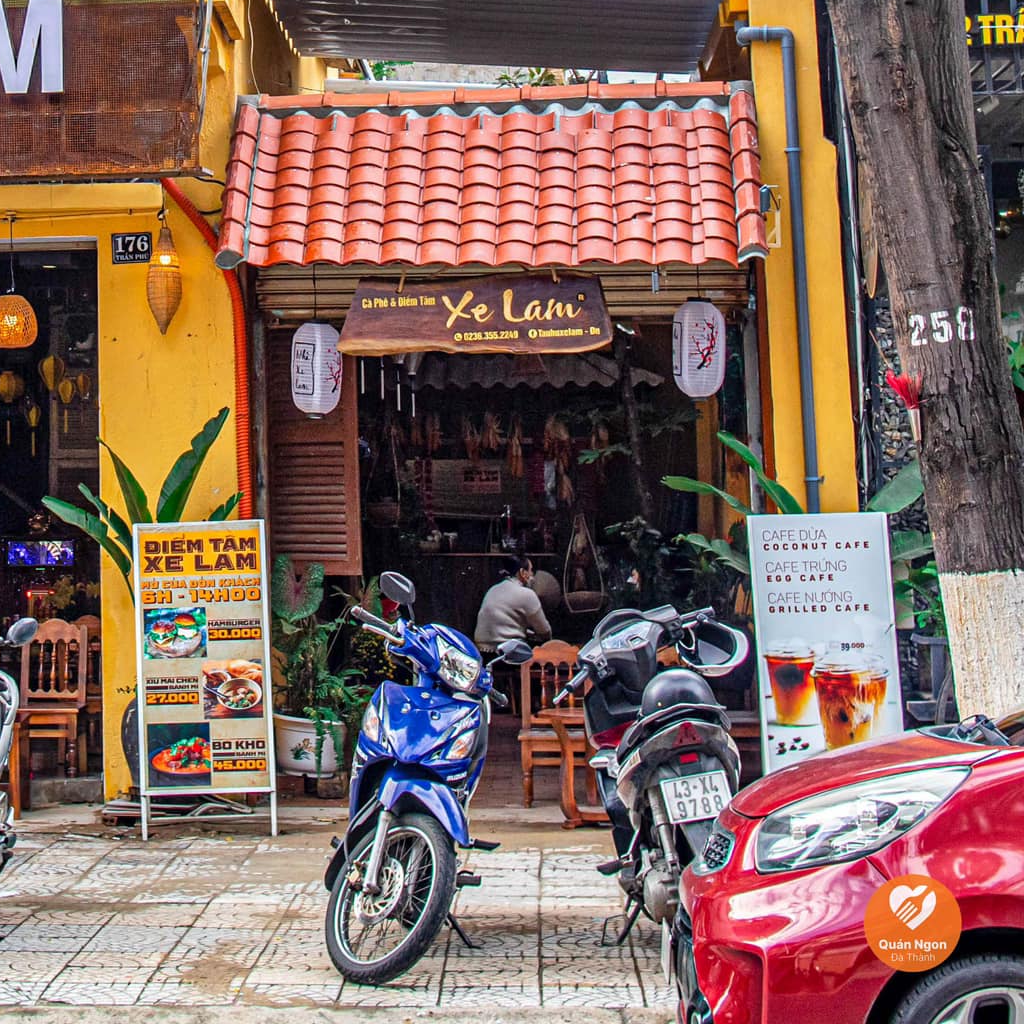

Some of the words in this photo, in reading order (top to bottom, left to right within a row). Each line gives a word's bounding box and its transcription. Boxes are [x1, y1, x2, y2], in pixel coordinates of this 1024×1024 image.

[115, 236, 149, 253] 176
[441, 290, 495, 329] Xe
[502, 288, 582, 323] Lam
[762, 530, 796, 542] CAFE
[763, 542, 828, 551] COCONUT
[835, 541, 870, 550] CAFE
[144, 555, 184, 573] XE
[194, 553, 257, 571] LAM
[765, 561, 799, 573] CAFE
[767, 574, 792, 583] EGG
[800, 574, 834, 582] CAFE
[141, 590, 173, 605] 6H
[189, 587, 261, 603] 14H00
[767, 592, 801, 605] CAFE
[769, 605, 828, 614] GRILLED
[835, 603, 870, 612] CAFE
[208, 628, 261, 640] 30.000
[146, 692, 199, 705] 27.000
[235, 740, 265, 750] KHO
[213, 759, 266, 772] 45.000
[676, 795, 724, 819] 9788
